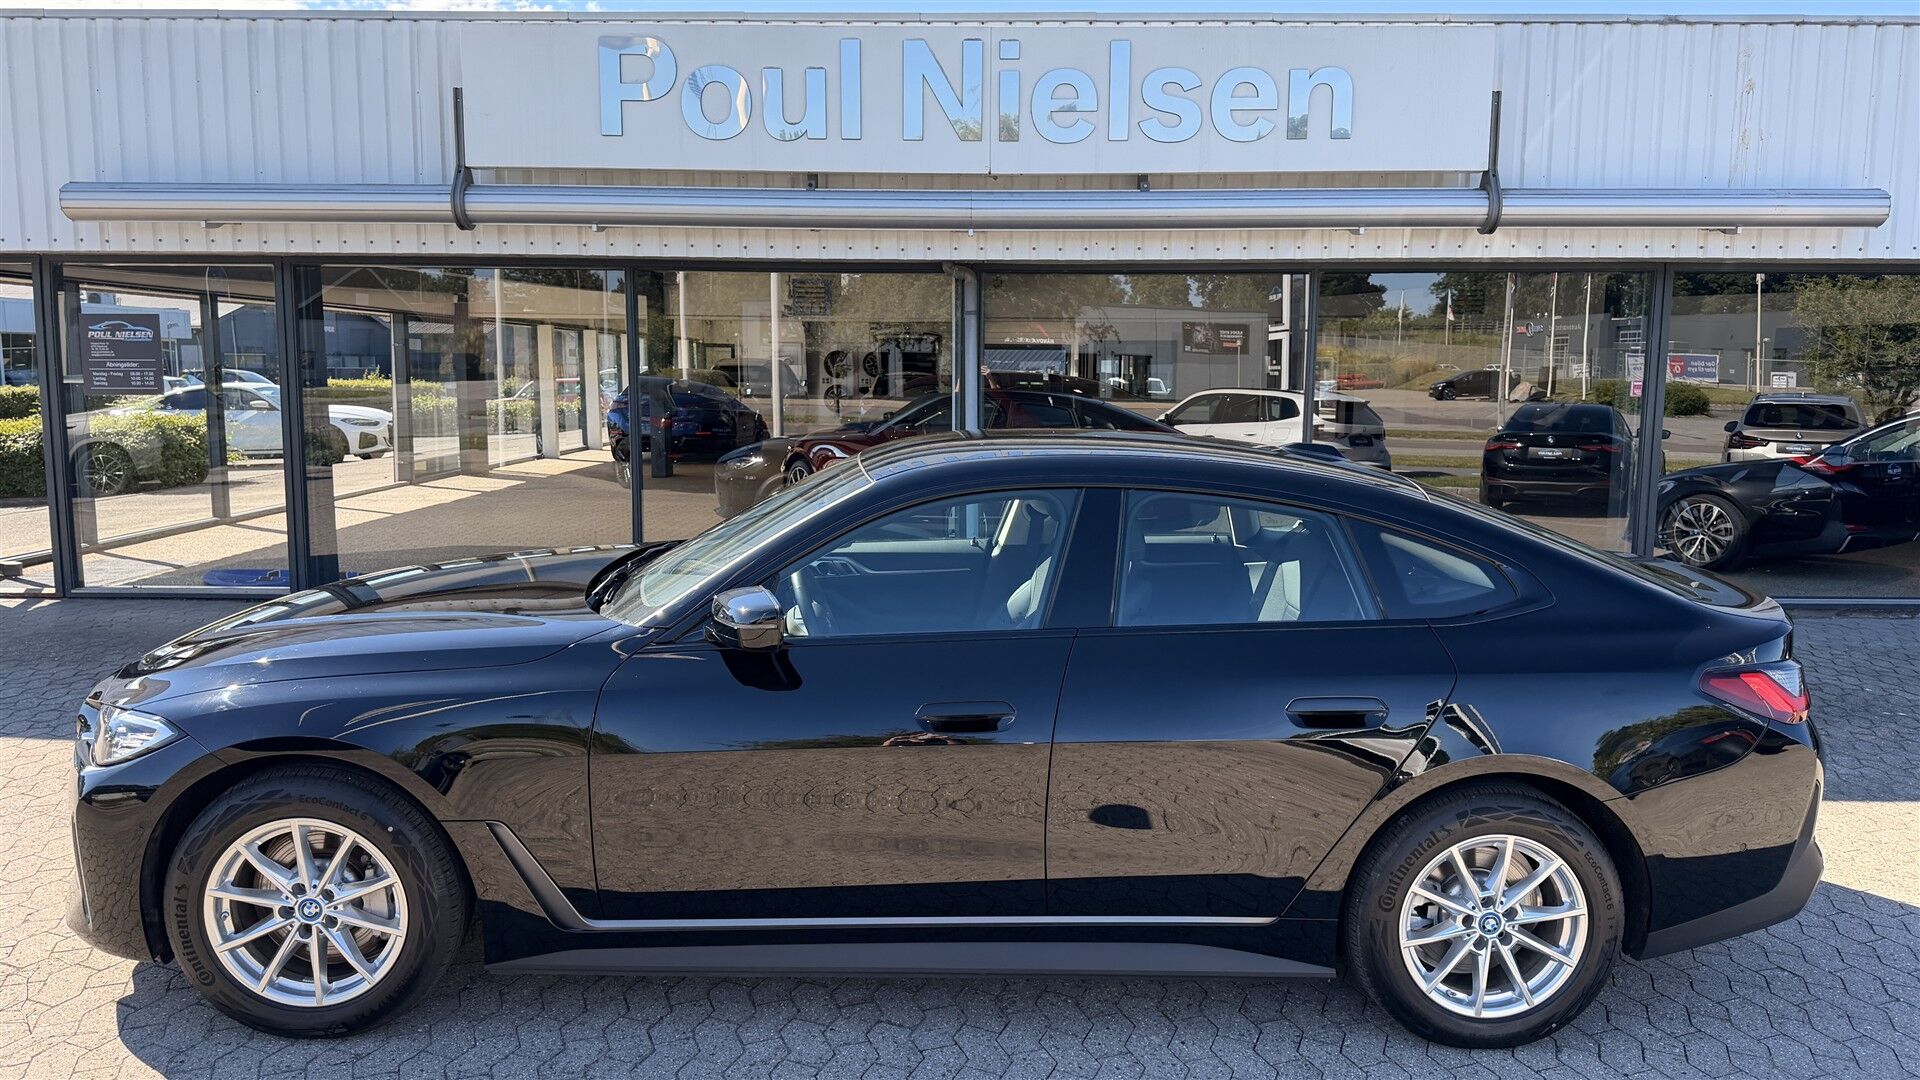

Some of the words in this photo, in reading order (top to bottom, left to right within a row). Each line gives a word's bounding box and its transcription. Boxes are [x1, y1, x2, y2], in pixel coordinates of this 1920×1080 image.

[598, 36, 862, 142] Poul
[902, 38, 1354, 144] Nielsen
[299, 794, 360, 816] EcoContact
[1378, 830, 1441, 912] Continental
[1584, 851, 1612, 902] EcoContact
[1606, 903, 1614, 911] 6
[173, 896, 216, 987] Continental
